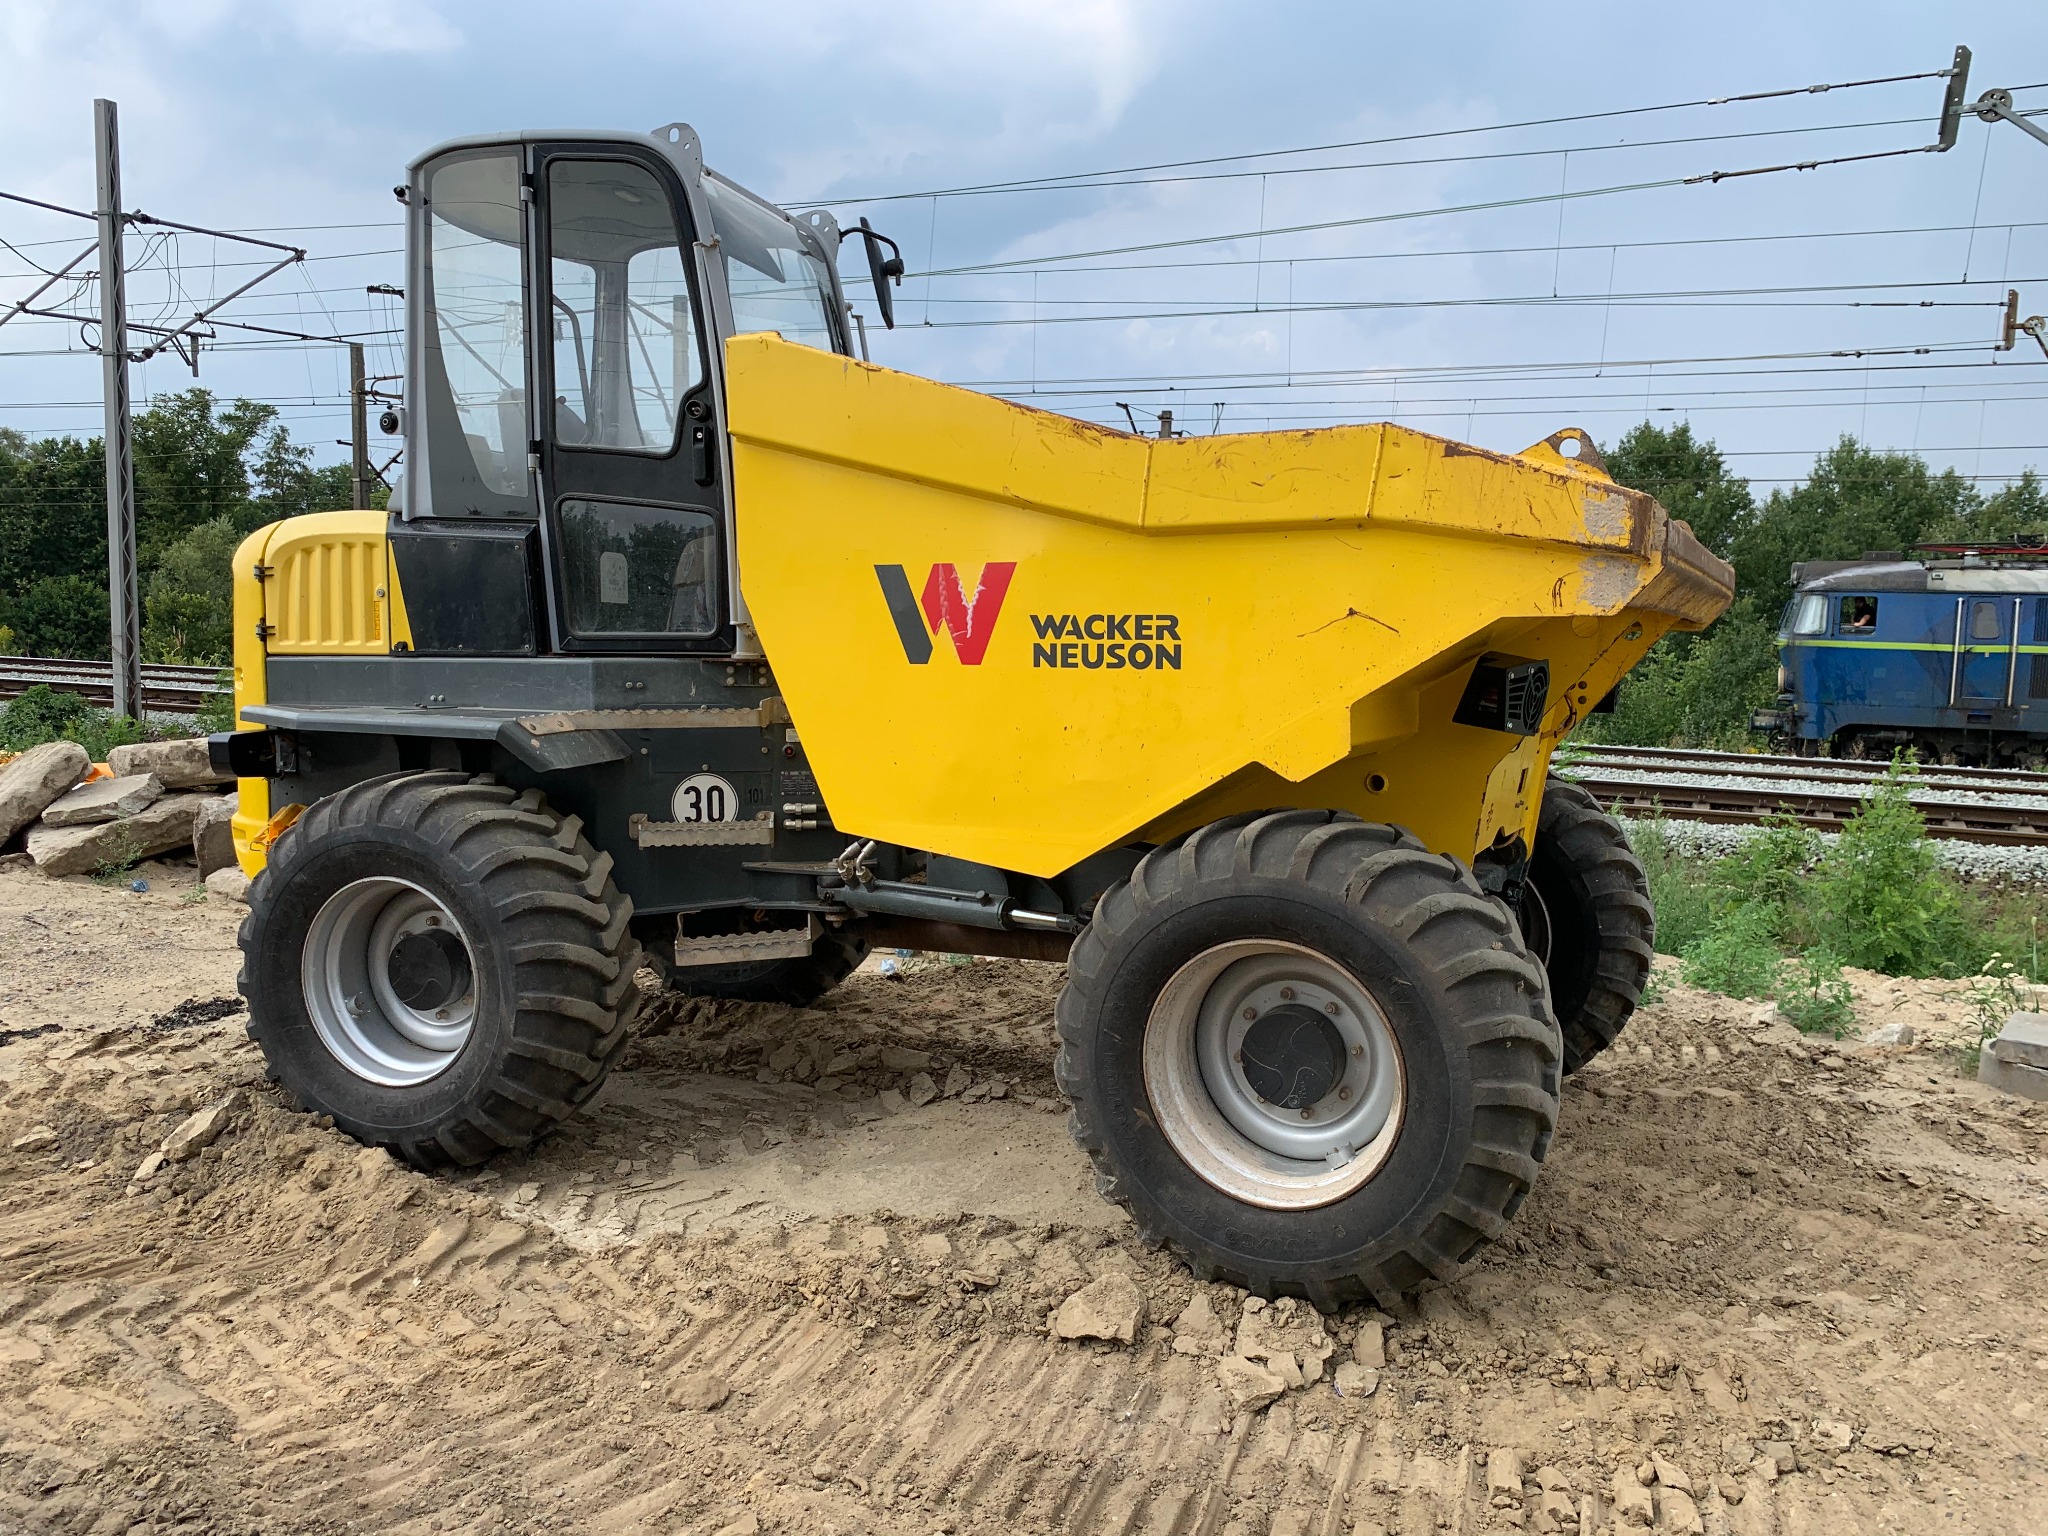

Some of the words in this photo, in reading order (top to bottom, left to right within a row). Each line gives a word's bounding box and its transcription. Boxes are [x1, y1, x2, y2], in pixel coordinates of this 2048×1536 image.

[1029, 614, 1182, 640] WACKER
[1033, 643, 1182, 670] NEUSON
[684, 785, 725, 823] 30
[748, 788, 764, 804] 101
